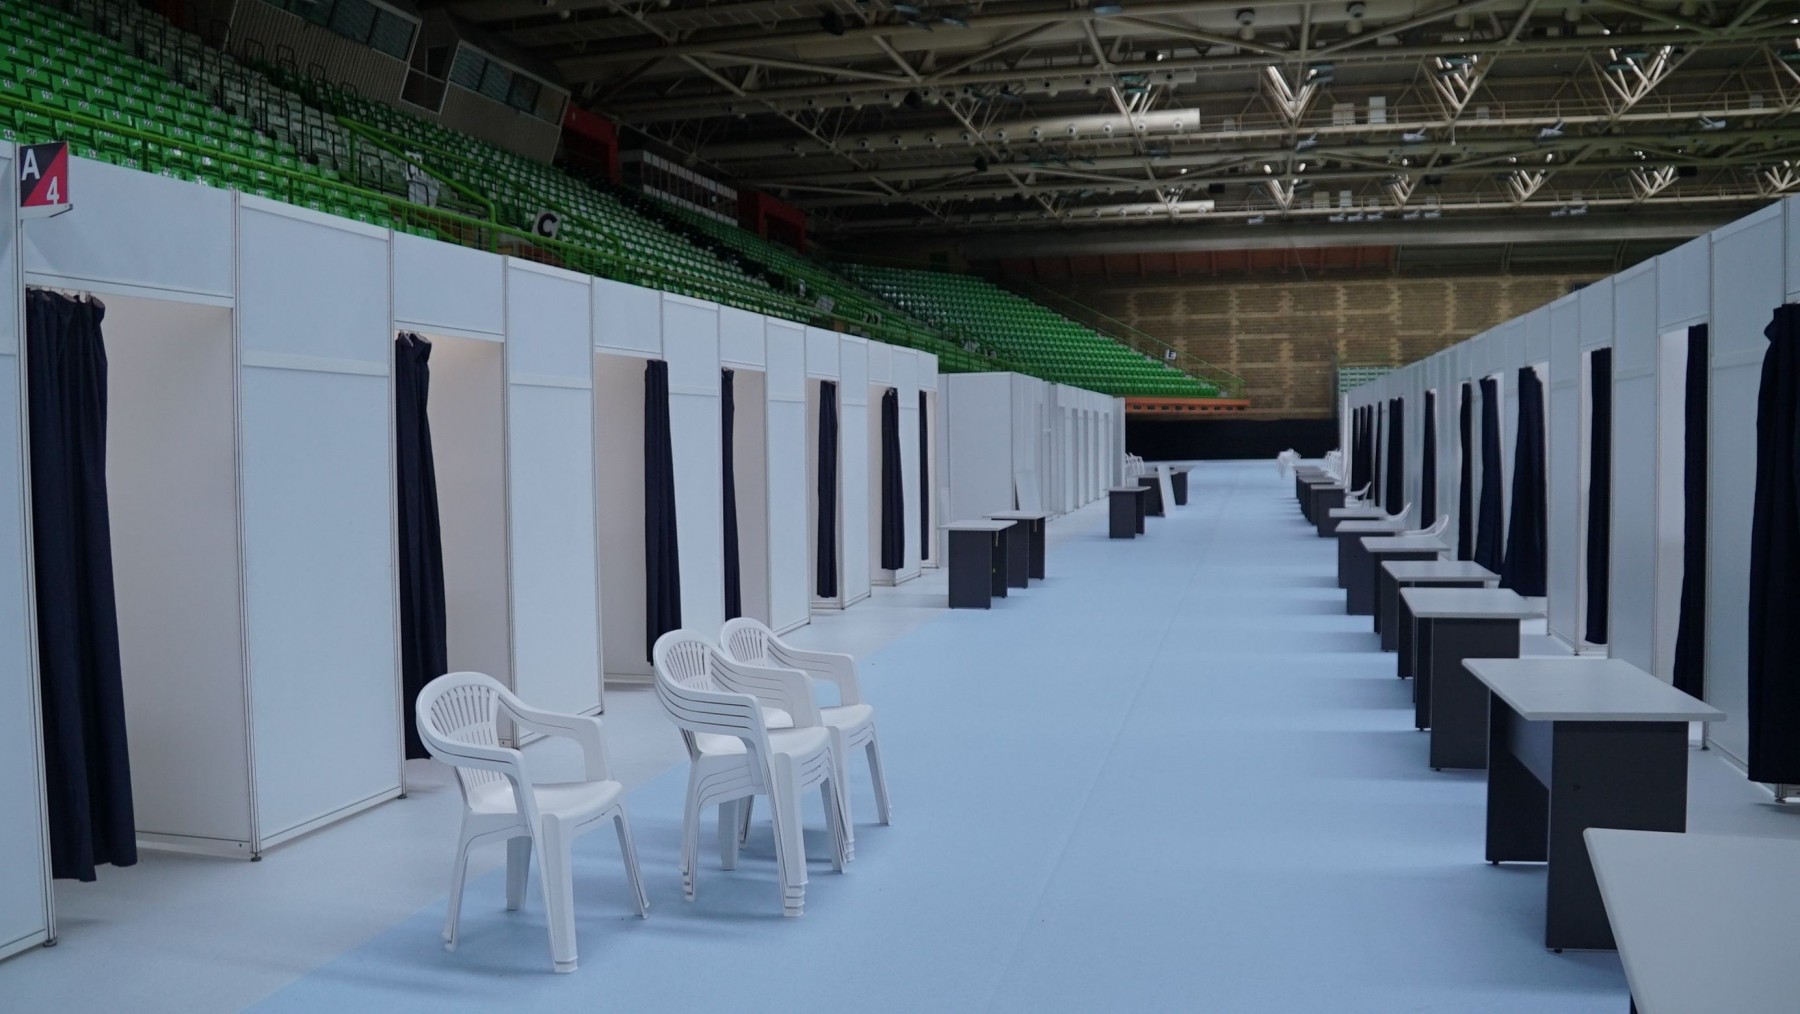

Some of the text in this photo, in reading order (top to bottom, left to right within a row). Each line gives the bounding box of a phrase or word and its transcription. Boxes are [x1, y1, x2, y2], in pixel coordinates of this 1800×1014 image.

[21, 148, 41, 181] A
[46, 176, 60, 206] 4
[537, 213, 558, 238] C
